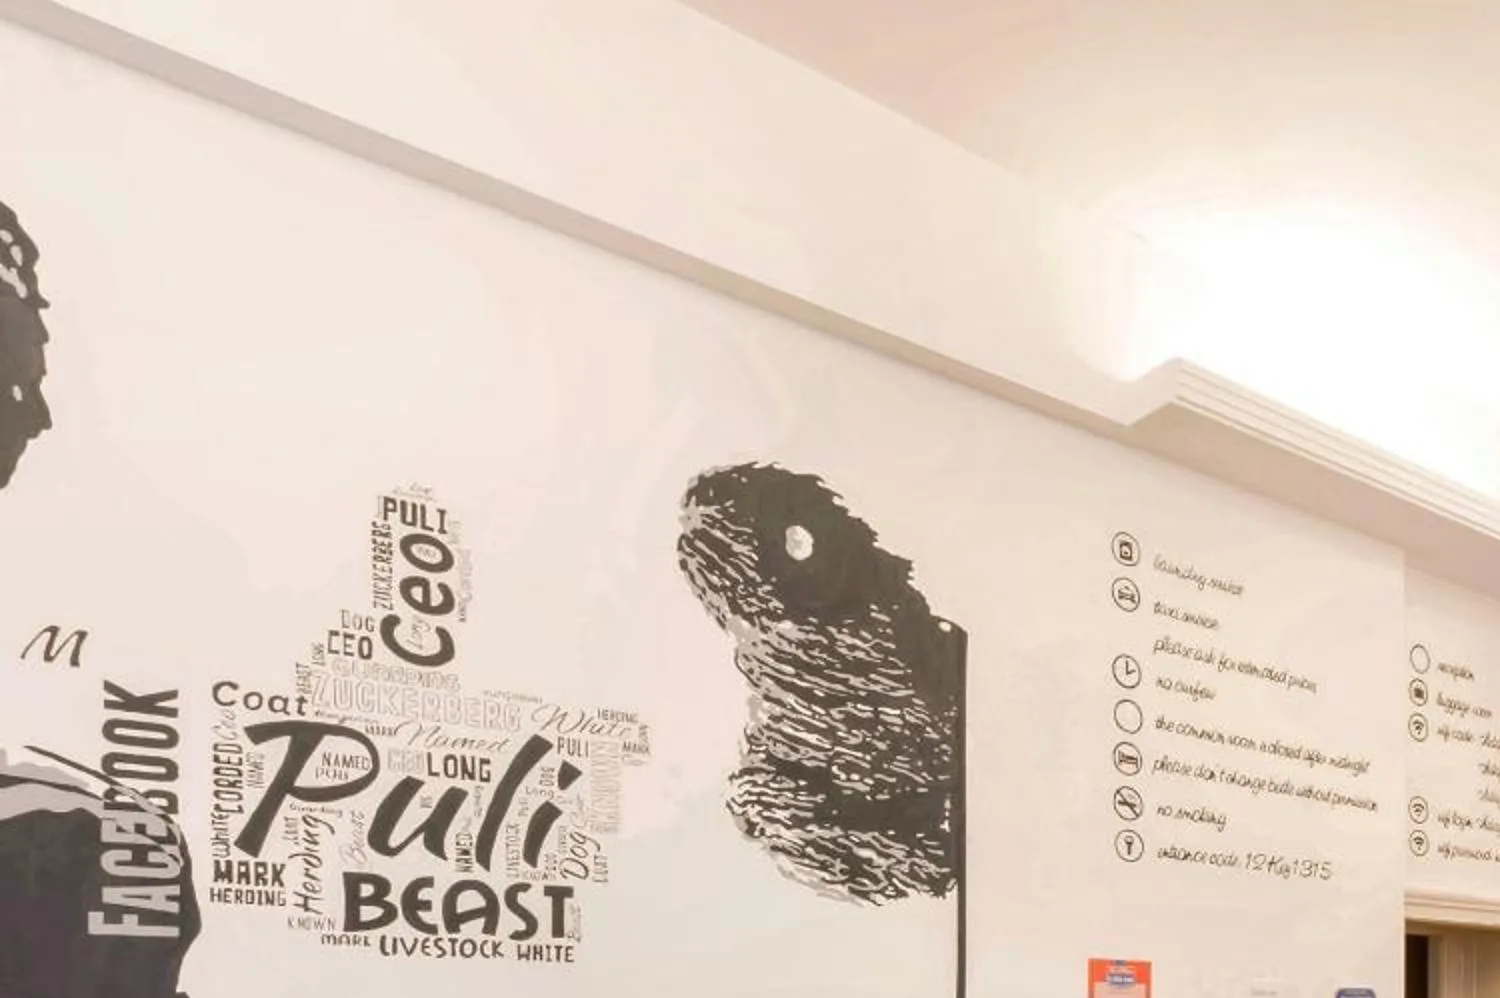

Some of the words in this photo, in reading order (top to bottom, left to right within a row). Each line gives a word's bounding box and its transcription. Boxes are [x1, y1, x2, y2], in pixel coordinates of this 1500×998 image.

[383, 496, 448, 534] PULI
[340, 609, 375, 632] DOG
[327, 630, 373, 660] CEO
[212, 681, 308, 716] Coat
[311, 671, 521, 732] ZUCKERBERG
[531, 702, 632, 736] White
[321, 752, 372, 771] NAMED
[557, 736, 589, 758] PULI
[213, 743, 243, 814] CORDED
[427, 752, 491, 783] LONG
[88, 679, 180, 937] FACEBOOK
[234, 720, 583, 873] Puli
[559, 825, 601, 880] Dog
[213, 860, 286, 888] MARK
[209, 887, 287, 907] HERDING
[343, 871, 574, 941] BEAST
[287, 917, 336, 932] KNOWN
[379, 934, 505, 959] LIVESTOCK
[517, 943, 575, 963] WHITE
